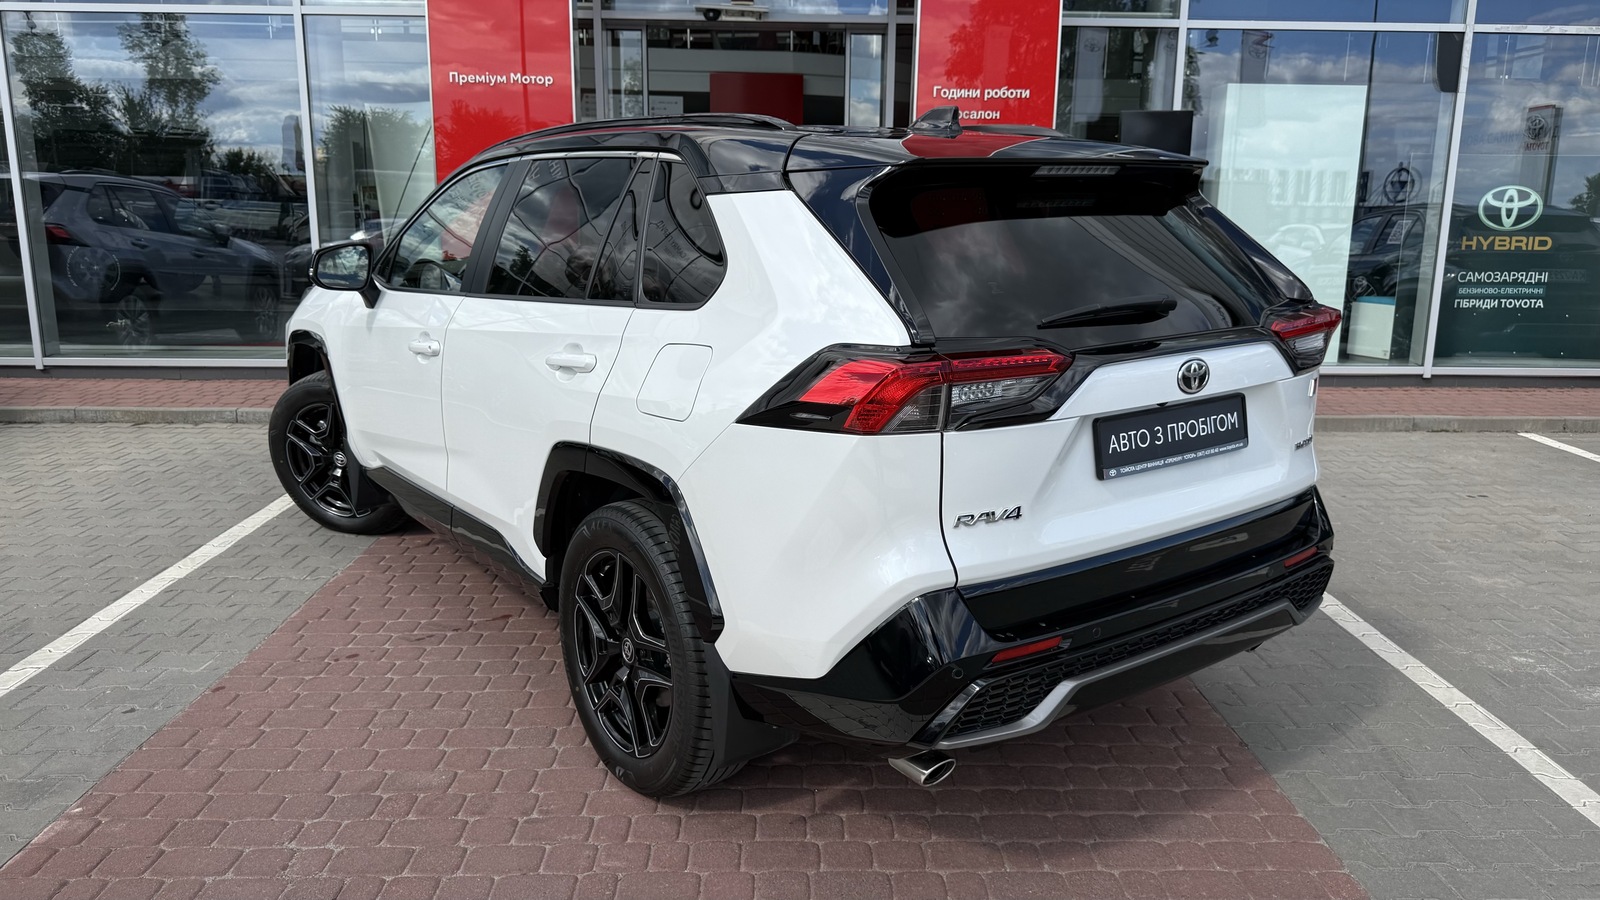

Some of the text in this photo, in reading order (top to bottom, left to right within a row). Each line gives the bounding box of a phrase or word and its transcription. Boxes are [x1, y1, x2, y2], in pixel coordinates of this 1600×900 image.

[448, 71, 554, 88] Преміум Мотор
[933, 85, 1030, 101] Години роботи
[1460, 235, 1553, 251] HYBRID
[1457, 271, 1549, 285] САМОЗАРЯДНІ
[1458, 287, 1544, 295] БЕНЗИНОВО-ЕЛЕКТРИЧНІ
[1454, 298, 1544, 310] ГІБРИДИ TOYOTA
[1109, 429, 1150, 454] АВТО
[1167, 411, 1239, 442] ПРОБІГОМ
[953, 504, 1023, 528] RAV4
